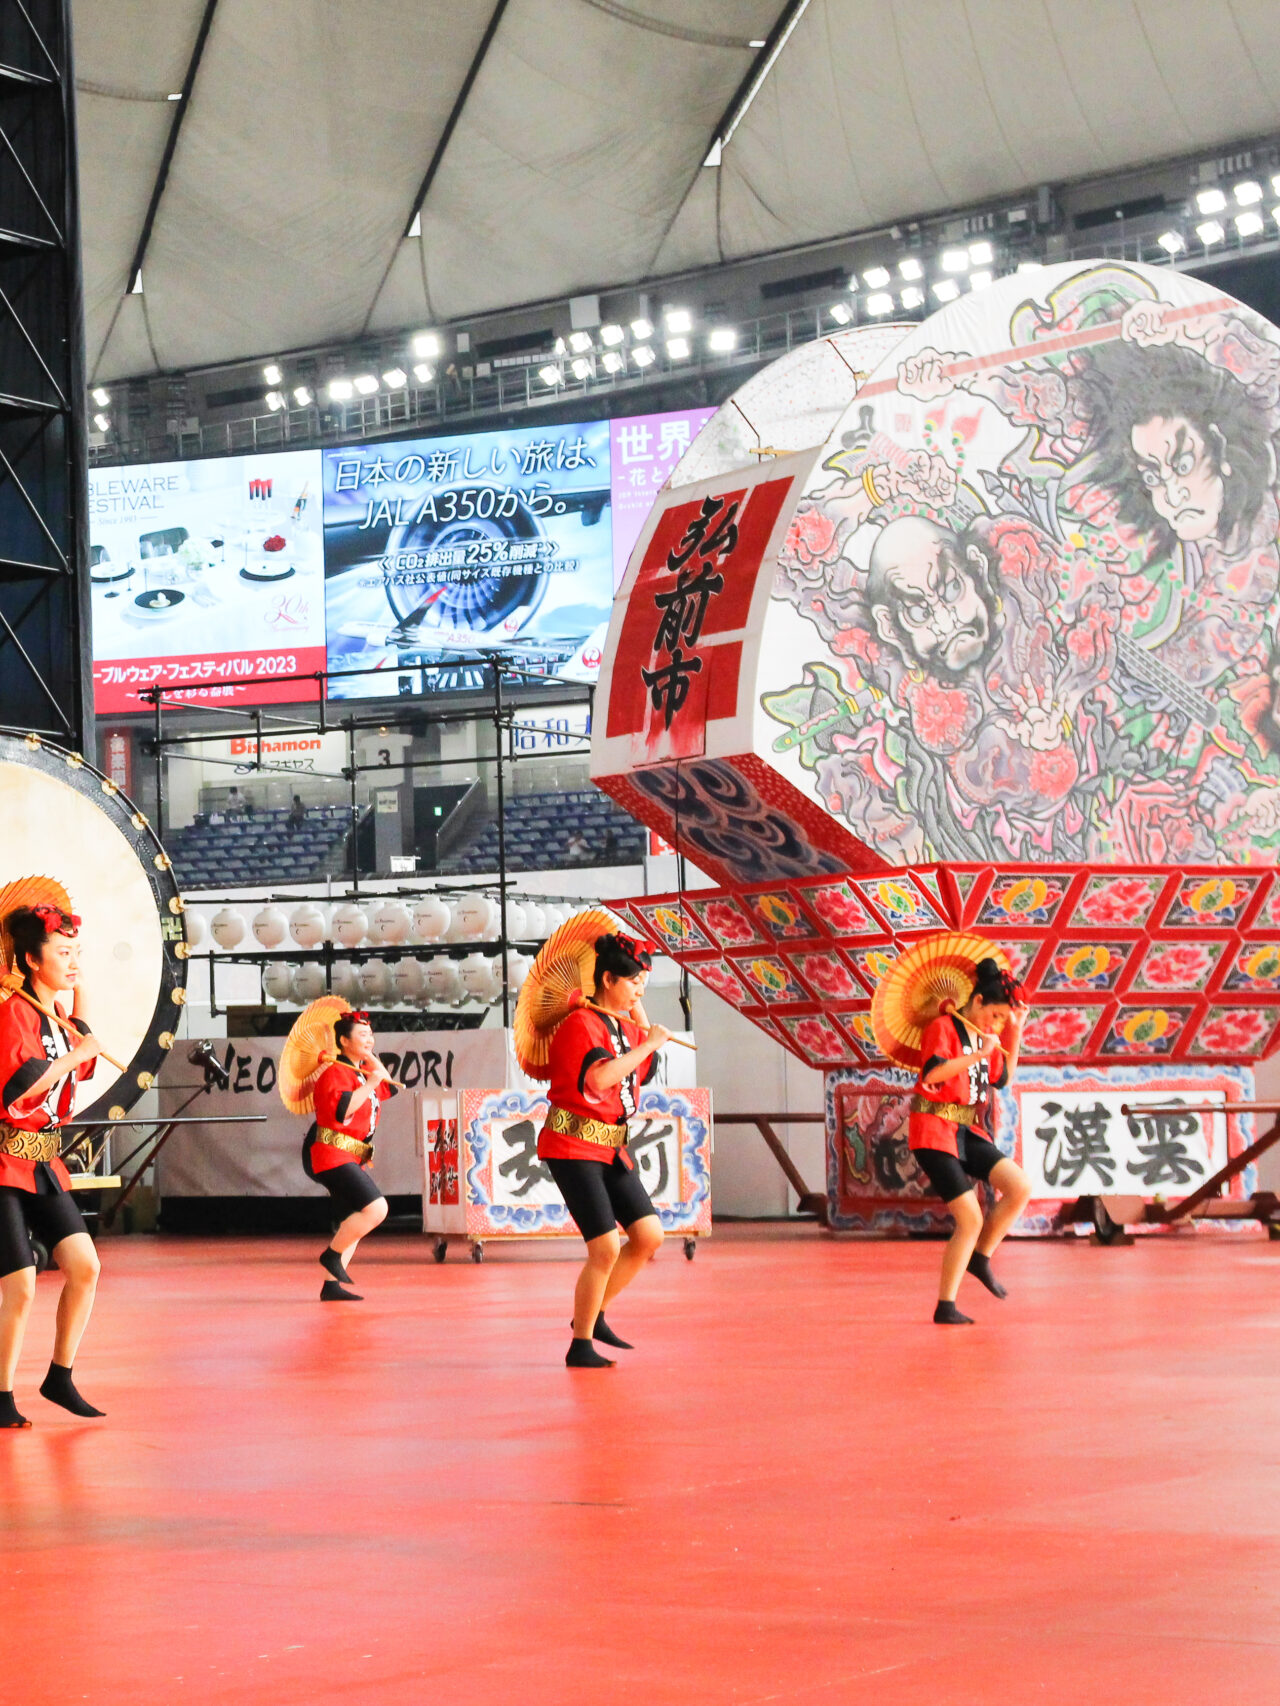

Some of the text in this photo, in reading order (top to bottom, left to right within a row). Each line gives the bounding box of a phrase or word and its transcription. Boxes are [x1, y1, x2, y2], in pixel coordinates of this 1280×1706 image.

[616, 418, 709, 465] 世界
[335, 437, 598, 492] 日本の新しい旅は、
[359, 499, 411, 530] JAL
[640, 494, 739, 732] 弘前市
[255, 655, 297, 675] 2023
[230, 737, 322, 756] Bishamon
[377, 748, 391, 766] 3
